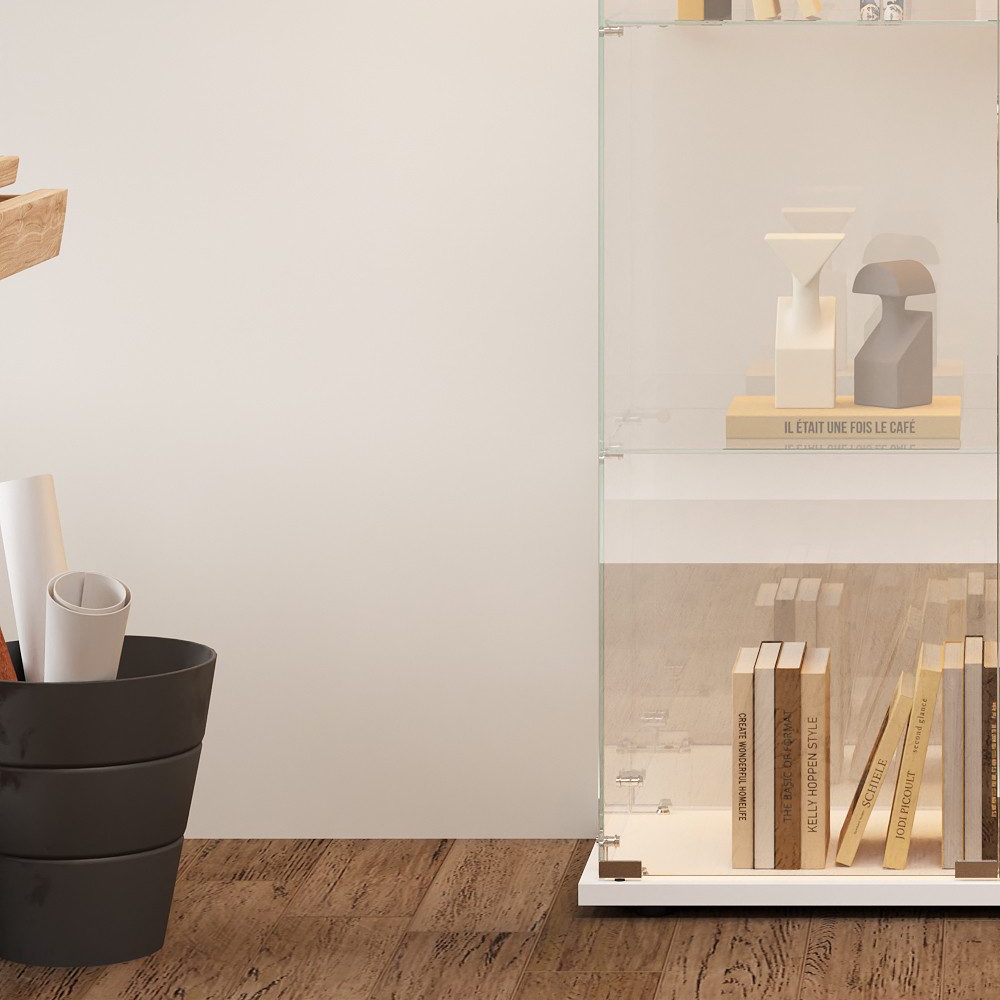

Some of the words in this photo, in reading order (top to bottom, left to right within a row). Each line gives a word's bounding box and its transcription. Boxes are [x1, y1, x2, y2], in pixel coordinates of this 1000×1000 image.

[784, 421, 794, 434] IL
[796, 419, 825, 434] ÉTAIT
[827, 421, 848, 434] UNE
[850, 421, 873, 434] FOIS
[875, 421, 888, 434] LE
[889, 418, 916, 434] CAFÉ
[738, 712, 747, 740] CREATE
[917, 698, 928, 725] glance
[807, 716, 818, 749] STYLE
[912, 725, 923, 753] second
[738, 740, 747, 784] WONDERFUL
[807, 753, 818, 797] HOPPEN
[783, 774, 793, 801] BASIC
[861, 758, 888, 808] SCHIELE
[900, 770, 916, 816] PICOULT
[738, 786, 747, 821] HOMELIFE
[783, 803, 793, 823] THE
[807, 800, 818, 833] KELLY
[895, 815, 908, 840] JODI
